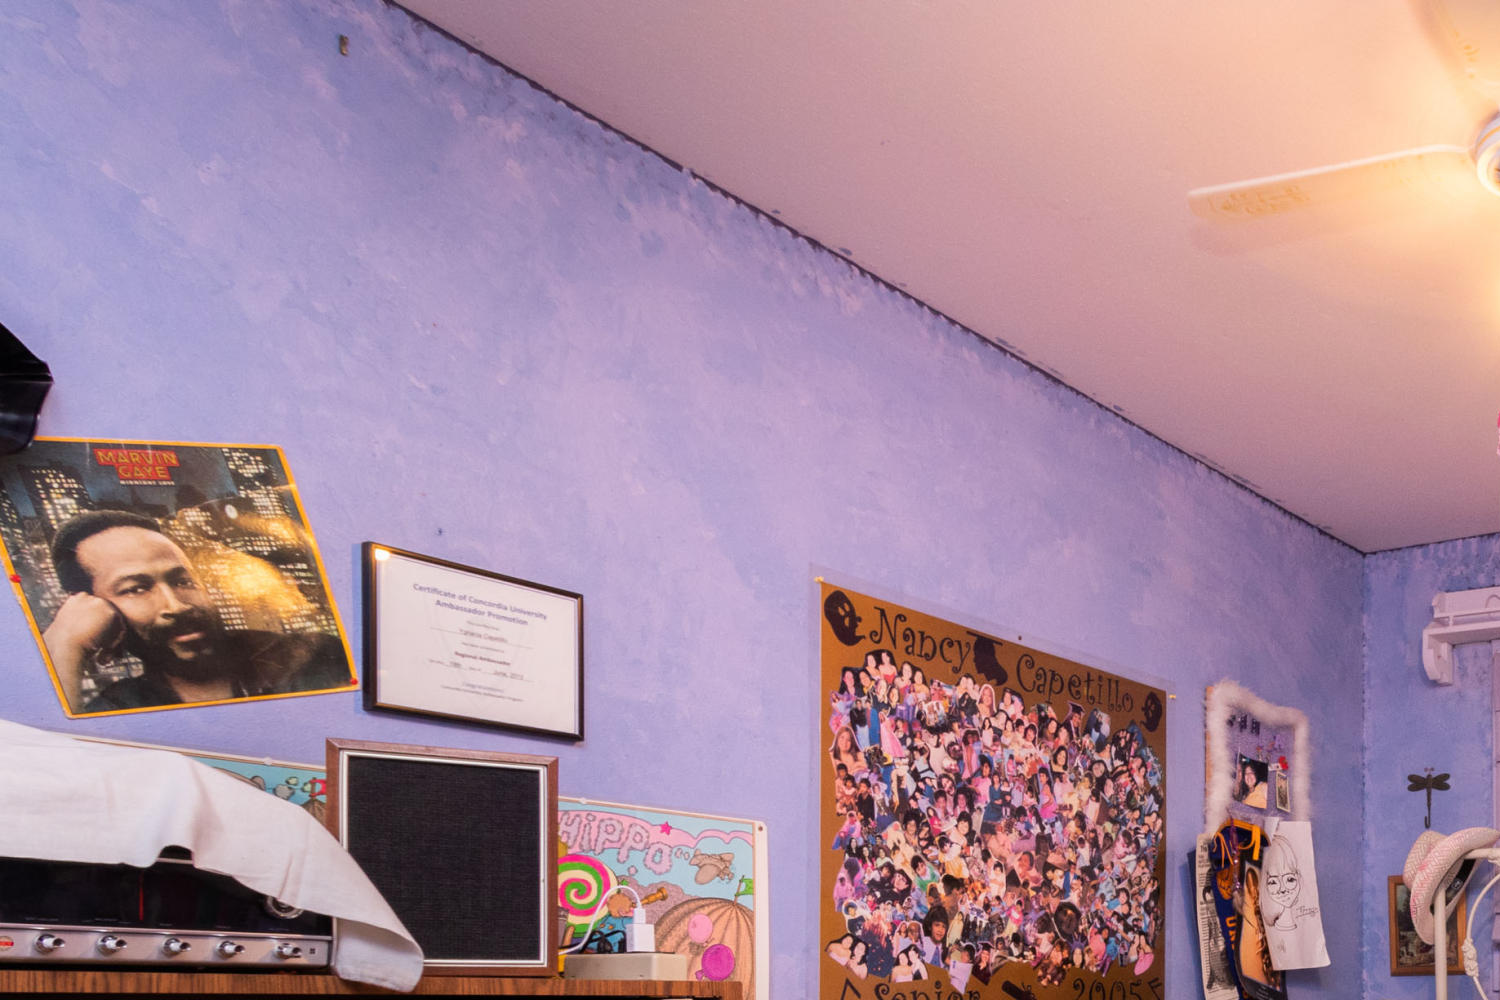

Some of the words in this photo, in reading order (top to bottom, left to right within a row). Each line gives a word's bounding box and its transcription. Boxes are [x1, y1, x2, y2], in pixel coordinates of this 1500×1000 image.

[97, 451, 178, 465] MARVIN
[118, 466, 168, 478] GAYE
[412, 583, 456, 599] Certificate
[458, 593, 467, 601] of
[468, 595, 508, 611] Concordia
[509, 604, 547, 621] University
[435, 599, 486, 616] Ambassador
[487, 610, 529, 625] Promotion
[870, 606, 971, 674] Nancy
[1016, 653, 1135, 714] Capetillo
